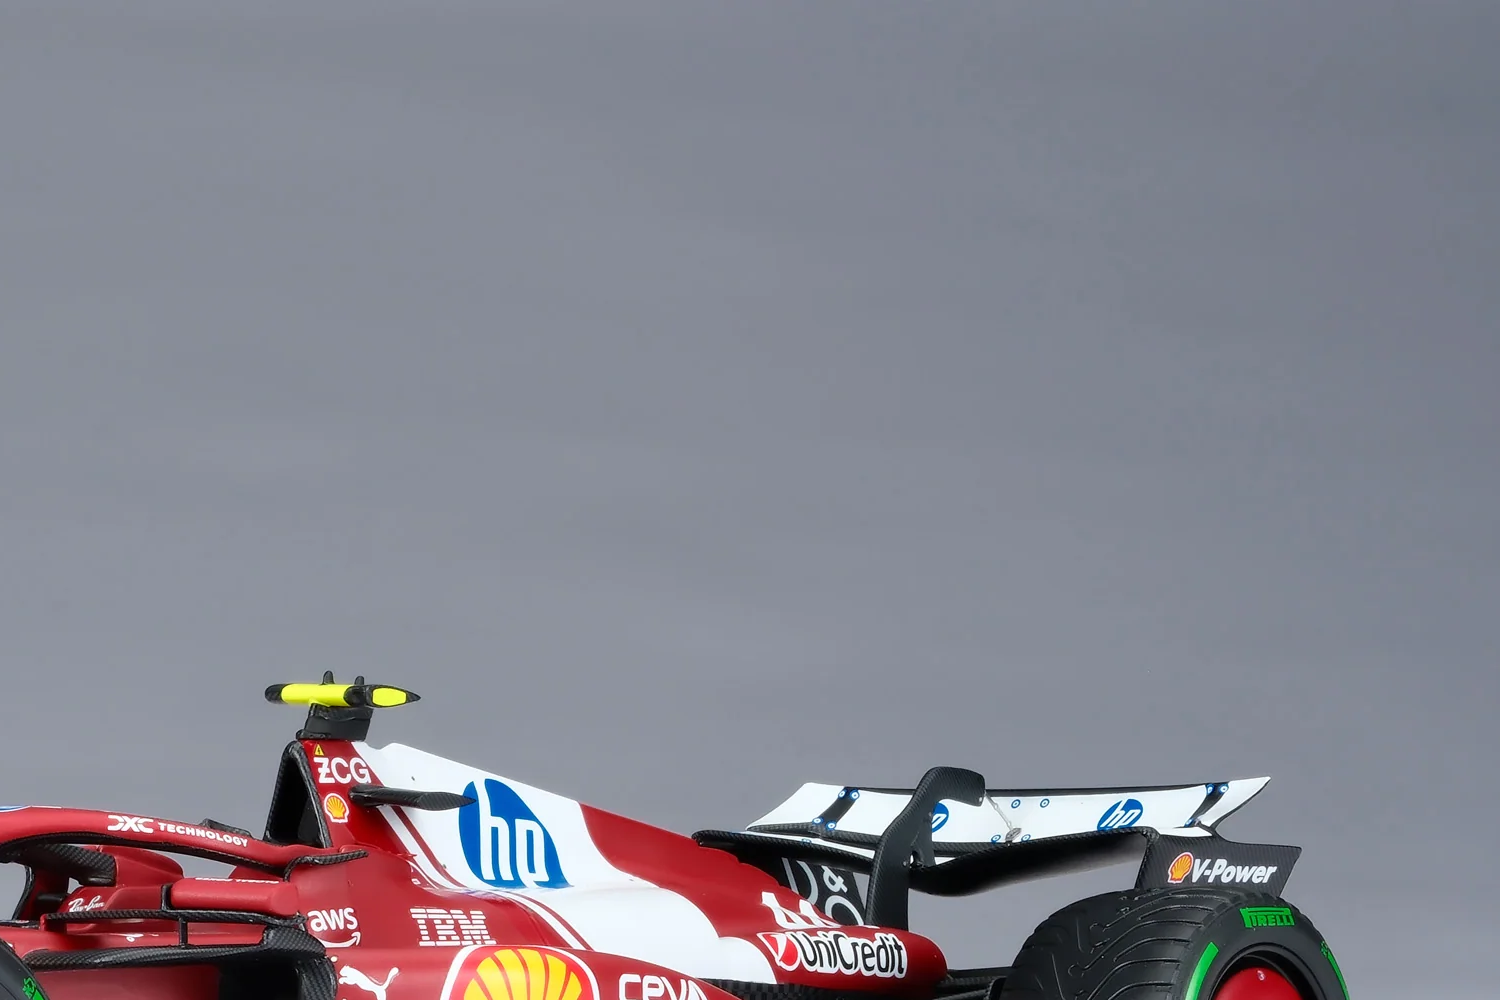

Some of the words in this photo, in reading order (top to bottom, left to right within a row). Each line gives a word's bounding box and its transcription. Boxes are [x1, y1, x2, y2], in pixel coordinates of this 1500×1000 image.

[314, 757, 372, 784] ZCG
[1101, 799, 1142, 830] hp
[107, 814, 154, 834] DXC
[158, 822, 248, 848] TECHNOLOGY
[468, 778, 560, 889] hp
[1192, 858, 1277, 883] V-Power
[307, 908, 358, 932] aws
[410, 908, 497, 946] IBM
[1240, 907, 1294, 927] PIRELLI
[793, 931, 904, 974] UniCredit
